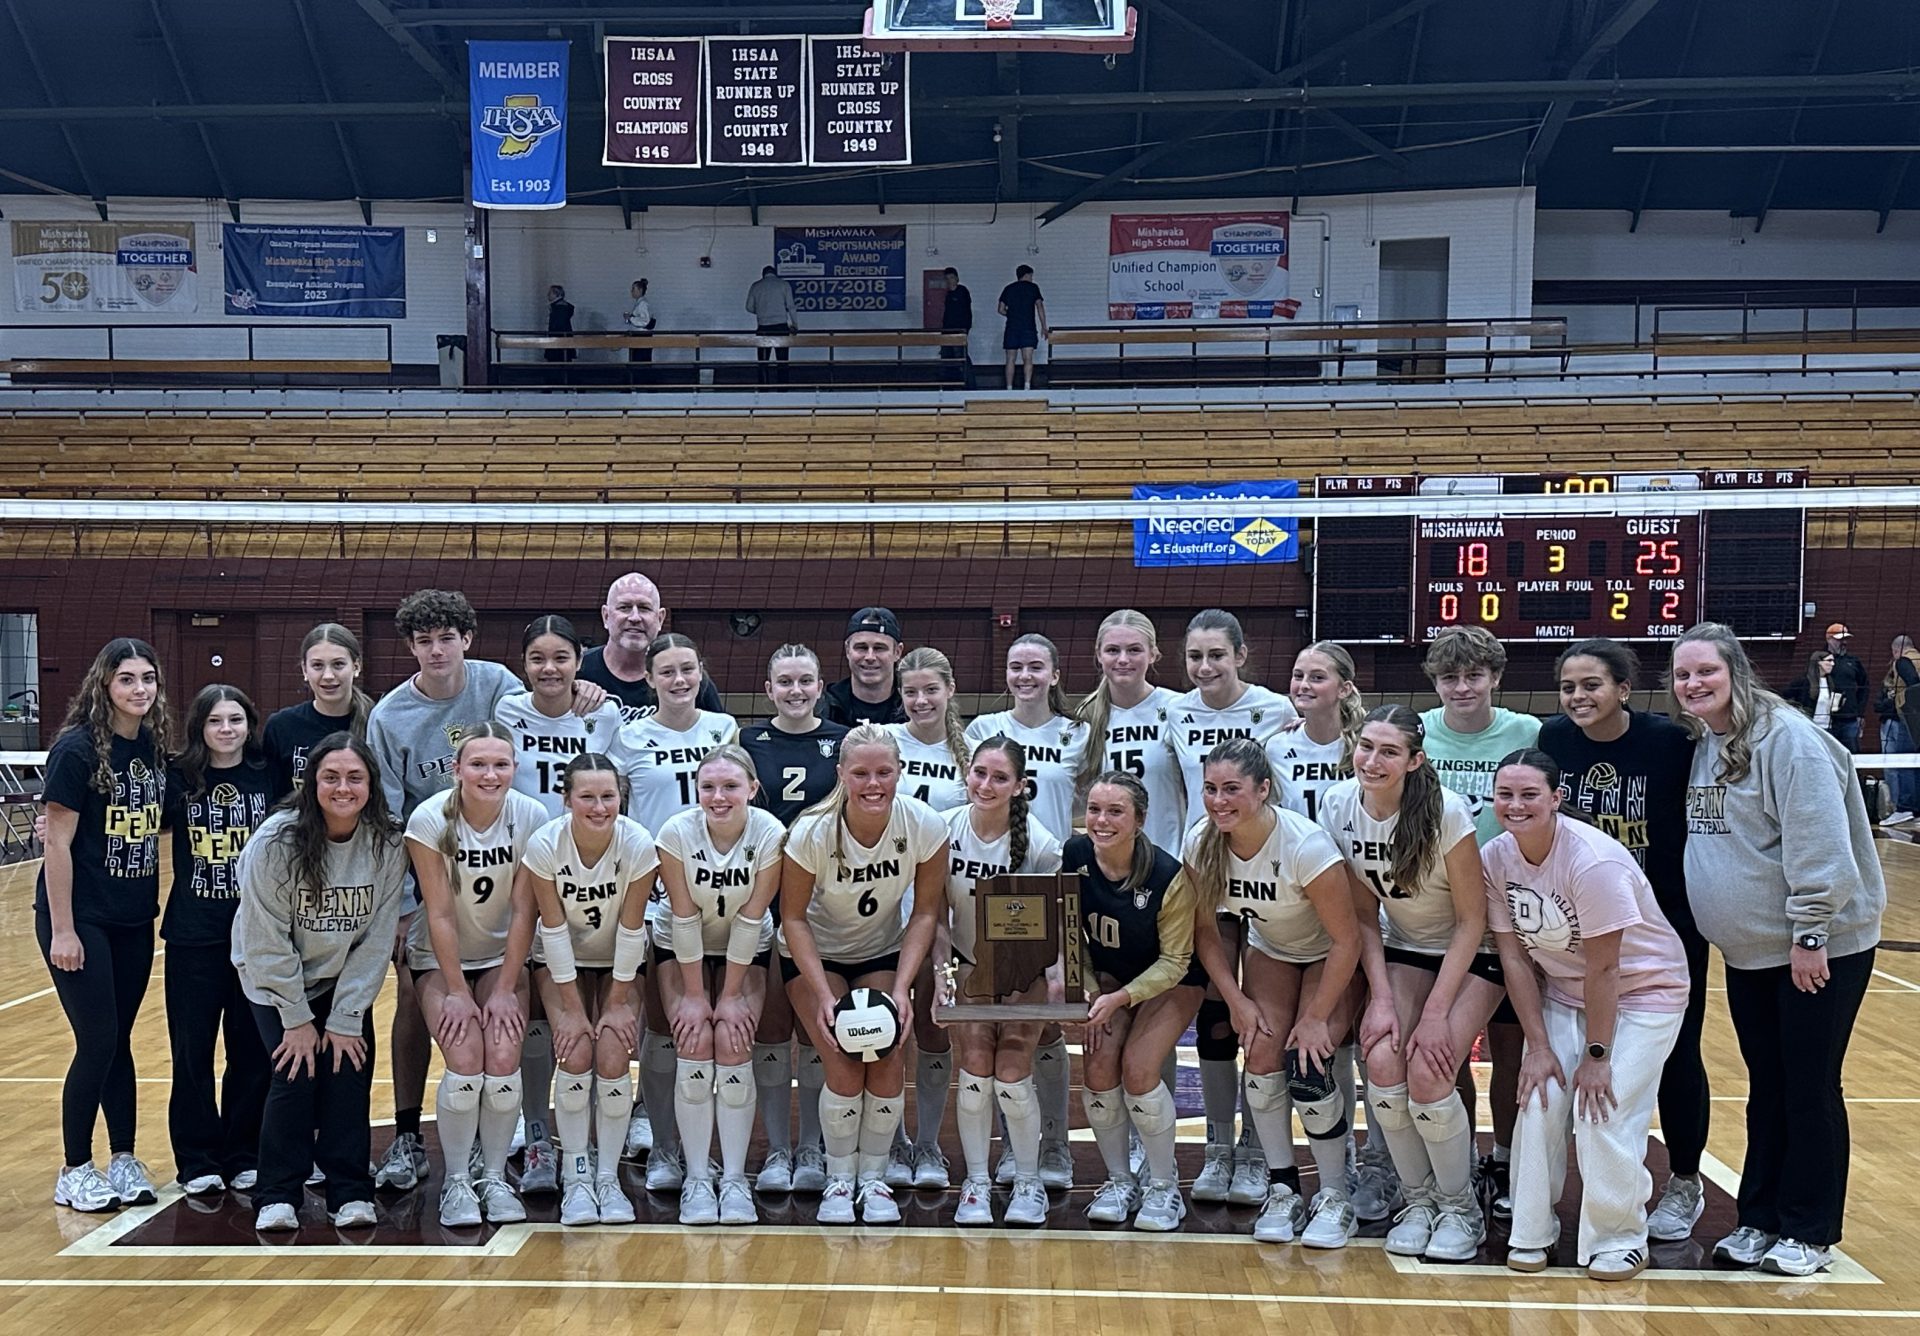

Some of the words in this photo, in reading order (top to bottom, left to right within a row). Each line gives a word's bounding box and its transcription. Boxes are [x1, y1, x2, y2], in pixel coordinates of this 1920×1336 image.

[631, 47, 676, 61] IHSAA
[732, 48, 779, 62] IHSAA
[479, 61, 560, 79] MEMBER
[733, 66, 778, 80] STATE
[836, 64, 881, 78] STATE
[632, 72, 673, 86] CROSS
[716, 85, 773, 100] RUNNER
[777, 84, 795, 99] UP
[821, 82, 876, 96] RUNNER
[880, 82, 899, 95] UP
[623, 97, 683, 111] COUNTRY
[837, 101, 880, 115] CROSS
[734, 104, 778, 119] CROSS
[615, 121, 689, 134] CHAMPIONS
[723, 123, 789, 138] COUNTRY
[827, 119, 893, 134] COUNTRY
[634, 145, 670, 159] 1946
[740, 143, 774, 157] 1948
[843, 139, 877, 153] 1949
[491, 179, 516, 193] Est.
[518, 179, 551, 192] 1903
[41, 228, 88, 238] Mishawaka
[1137, 227, 1184, 237] Mishawaka
[1223, 230, 1273, 238] CHAMPIONS
[39, 240, 60, 250] High
[62, 239, 91, 249] School
[129, 239, 179, 248] CHAMPIONS
[269, 241, 292, 249] Quality
[818, 240, 904, 251] SPORTSMANSHIP
[1132, 239, 1153, 250] High
[1156, 238, 1189, 248] School
[1216, 243, 1280, 254] TOGETHER
[122, 253, 188, 264] TOGETHER
[265, 257, 313, 267] Mishawaka
[315, 257, 335, 268] High
[337, 258, 364, 267] School
[841, 252, 880, 263] AWARD
[834, 265, 888, 276] RECIPIENT
[1112, 261, 1153, 274] Unified
[1157, 261, 1217, 275] Champion
[266, 281, 304, 289] Exemplary
[305, 281, 332, 289] Athletic
[334, 281, 364, 290] Program
[795, 280, 887, 294] 2017-2018
[1144, 280, 1184, 292] School
[304, 291, 328, 300] 2023
[796, 296, 888, 310] 2019-2020
[1326, 479, 1348, 490] PLYR
[1357, 479, 1372, 490] FLS
[1385, 478, 1402, 489] PTS
[1715, 473, 1738, 484] PLYR
[1747, 473, 1763, 484] FLS
[1776, 472, 1794, 484] PTS
[1149, 516, 1235, 535] Needed
[1421, 521, 1504, 538] MISHAWAKA
[1626, 519, 1680, 535] GUEST
[1245, 537, 1276, 545] TODAY
[1536, 529, 1576, 541] PERIOD
[1163, 542, 1236, 555] Edustaff.org
[1458, 543, 1488, 576] 18
[1549, 545, 1565, 573] 3
[1636, 541, 1681, 574] 25
[1429, 583, 1464, 593] FOULS
[1477, 581, 1506, 592] T.O.L.
[1517, 581, 1559, 592] PLAYER
[1565, 580, 1594, 591] FOUL
[1648, 579, 1685, 591] FOULS
[1441, 594, 1458, 621] 0
[1481, 594, 1499, 621] 0
[1611, 593, 1628, 620] 2
[1662, 592, 1679, 619] 2
[1536, 626, 1574, 637] MATCH
[1647, 624, 1684, 635] SCORE
[523, 735, 586, 754] PENN
[416, 753, 454, 779] PE
[1110, 749, 1145, 780] 15
[782, 767, 807, 801] 2
[455, 845, 513, 869] PENN
[1352, 840, 1394, 862] PEN
[695, 867, 749, 889] PENN
[473, 876, 494, 905] 9
[562, 881, 618, 903] PENN
[1227, 878, 1277, 901] ENN
[296, 884, 374, 919] PENN
[716, 895, 726, 918] 1
[858, 887, 879, 918] 6
[583, 905, 602, 930] 3
[1088, 912, 1121, 949] 10
[1066, 897, 1080, 984] IHSAA
[847, 1026, 883, 1037] Wilson
